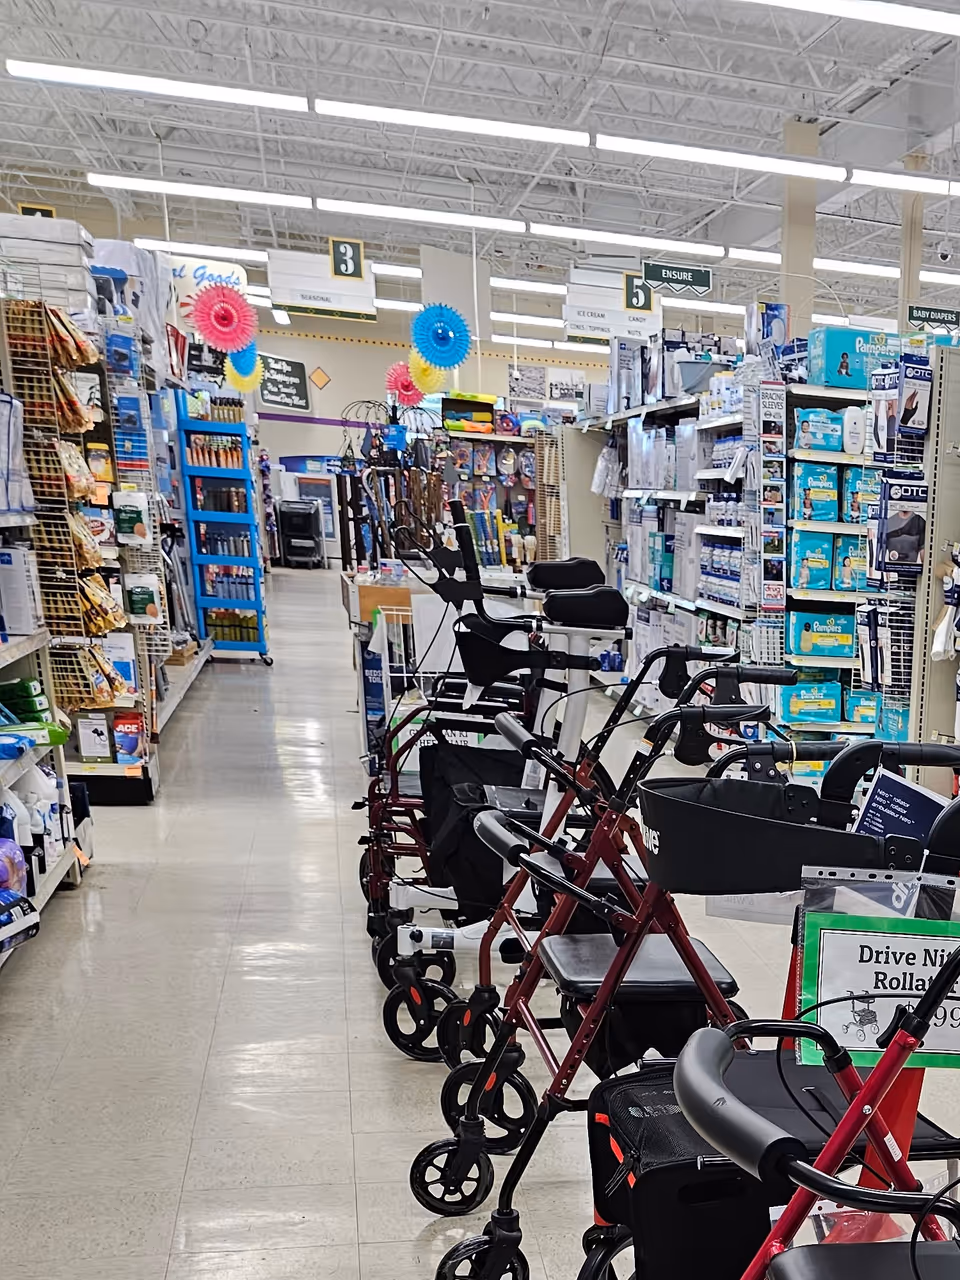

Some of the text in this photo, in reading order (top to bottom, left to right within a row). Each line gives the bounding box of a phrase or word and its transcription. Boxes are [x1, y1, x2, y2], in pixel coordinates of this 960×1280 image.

[339, 243, 355, 275] 3
[193, 264, 242, 287] Goods
[661, 269, 693, 281] ENSURE
[631, 278, 646, 308] 5
[912, 309, 956, 321] BABY DIAPERS
[913, 368, 932, 378] OTC
[761, 391, 785, 402] BRACING
[761, 401, 784, 410] SLEEVES
[901, 486, 928, 497] OTC
[813, 622, 842, 633] Pampers
[115, 724, 139, 733] ACE
[858, 944, 917, 966] Drive
[873, 971, 959, 995] Rollar
